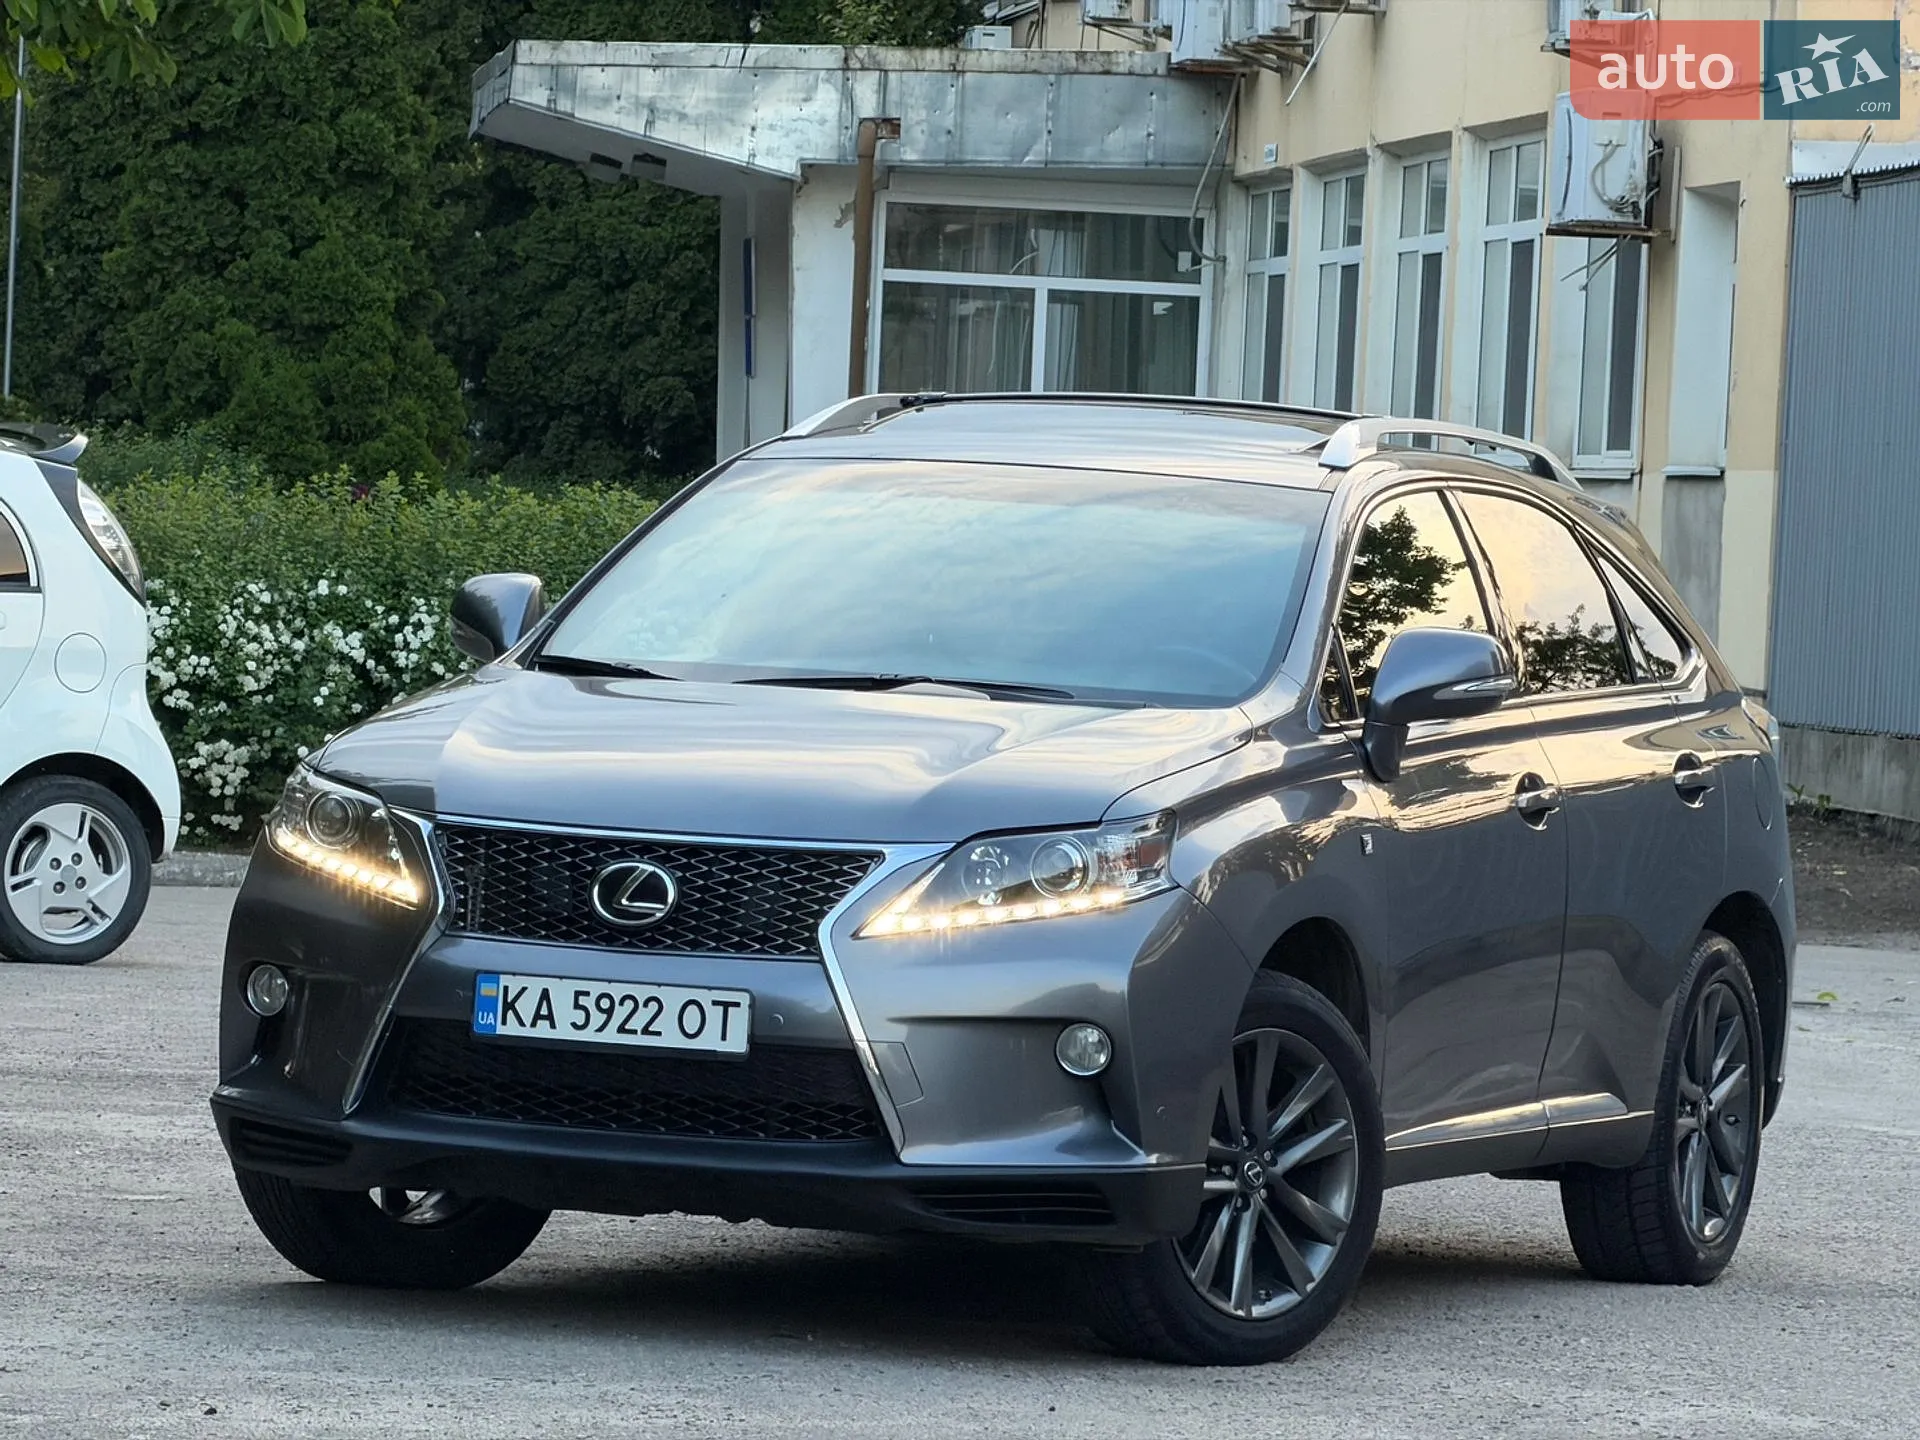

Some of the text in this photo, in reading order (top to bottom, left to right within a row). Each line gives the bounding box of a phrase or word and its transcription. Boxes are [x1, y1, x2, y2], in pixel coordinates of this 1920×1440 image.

[478, 1011, 496, 1025] UA
[501, 985, 742, 1042] KA 5922 OT
